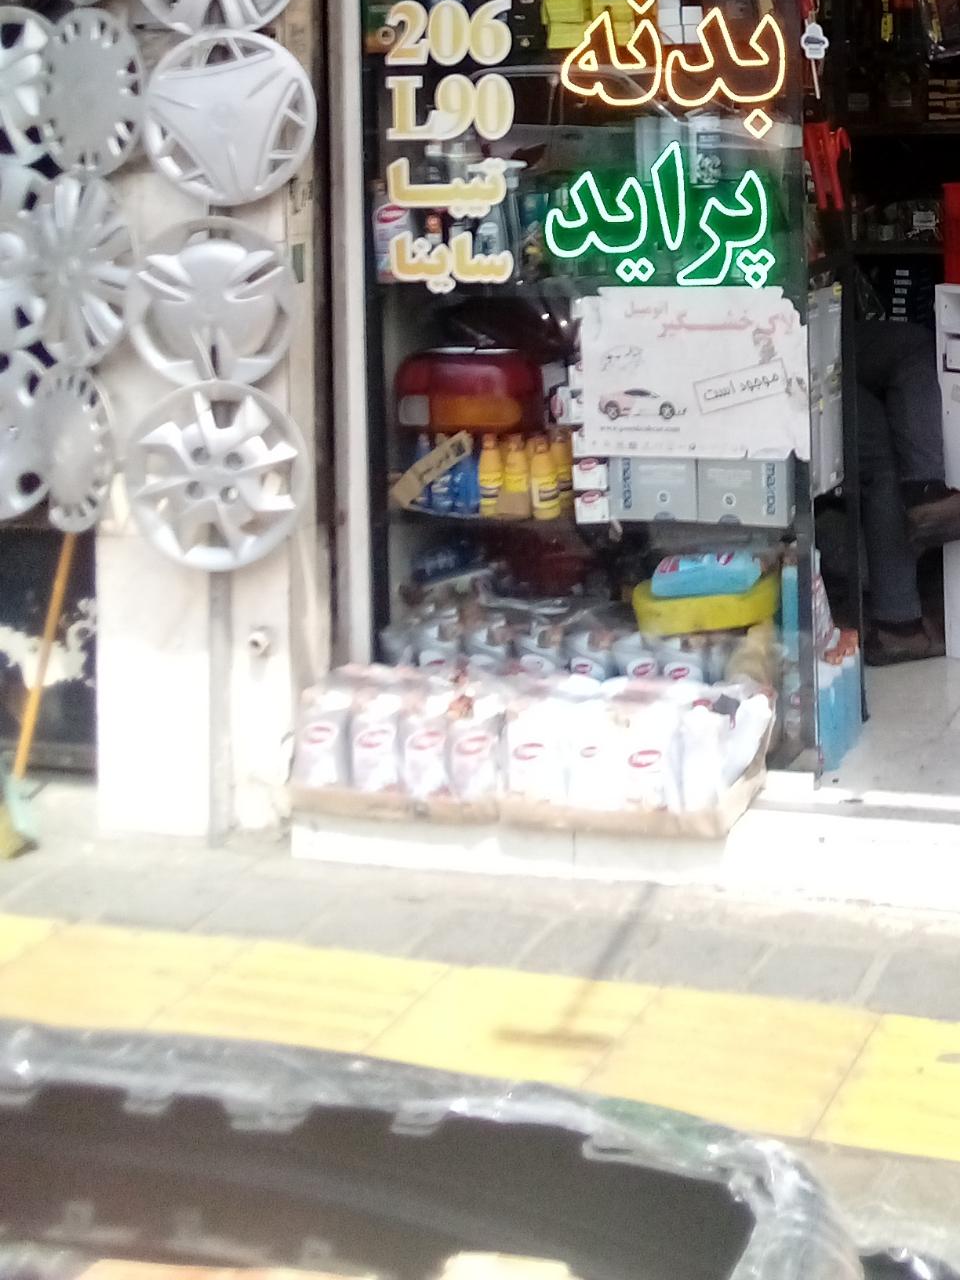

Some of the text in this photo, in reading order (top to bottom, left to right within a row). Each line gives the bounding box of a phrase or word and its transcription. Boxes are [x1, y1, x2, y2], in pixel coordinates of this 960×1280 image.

[385, 73, 516, 141] L90
[386, 157, 508, 219] تیبا
[545, 140, 777, 289] پراید
[388, 230, 515, 294] ساینا
[703, 373, 780, 401] موجود است
